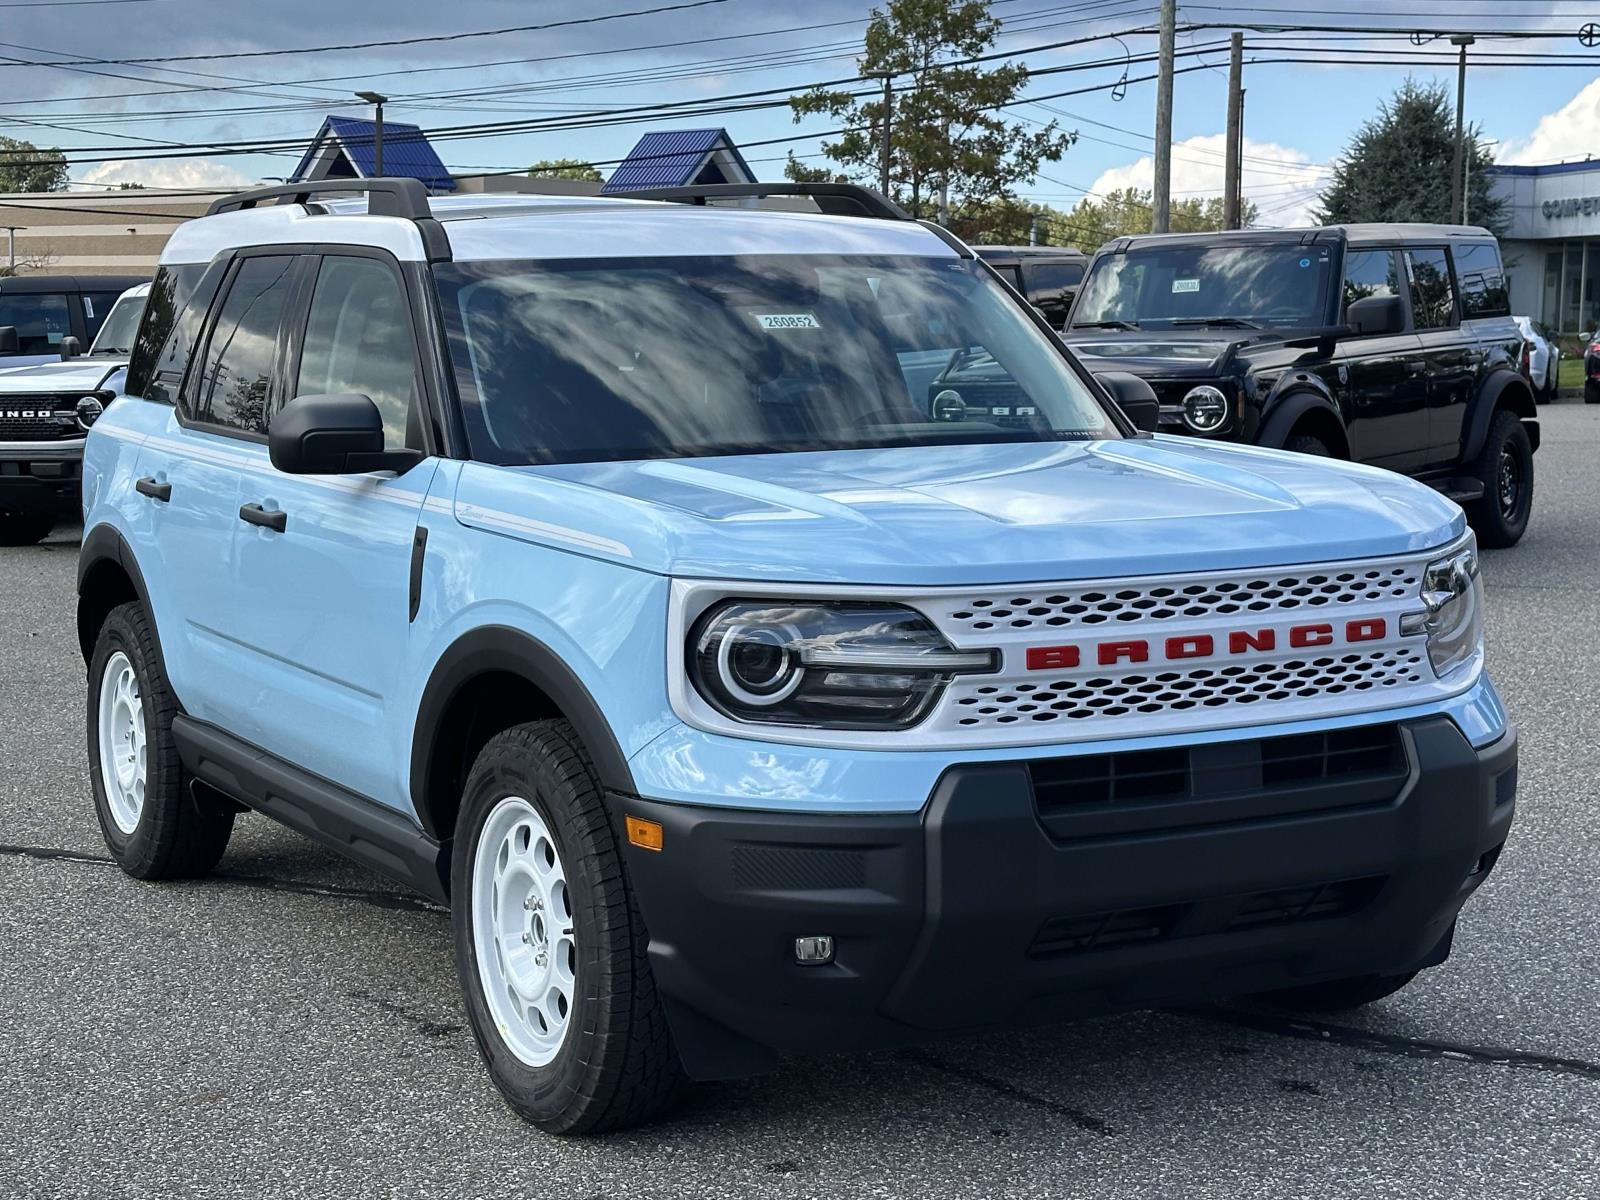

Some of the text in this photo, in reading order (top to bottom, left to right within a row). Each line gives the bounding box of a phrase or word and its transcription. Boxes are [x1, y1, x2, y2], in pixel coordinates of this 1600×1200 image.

[764, 316, 815, 328] 260852
[0, 410, 51, 418] NCO
[1025, 617, 1387, 671] BRONCO
